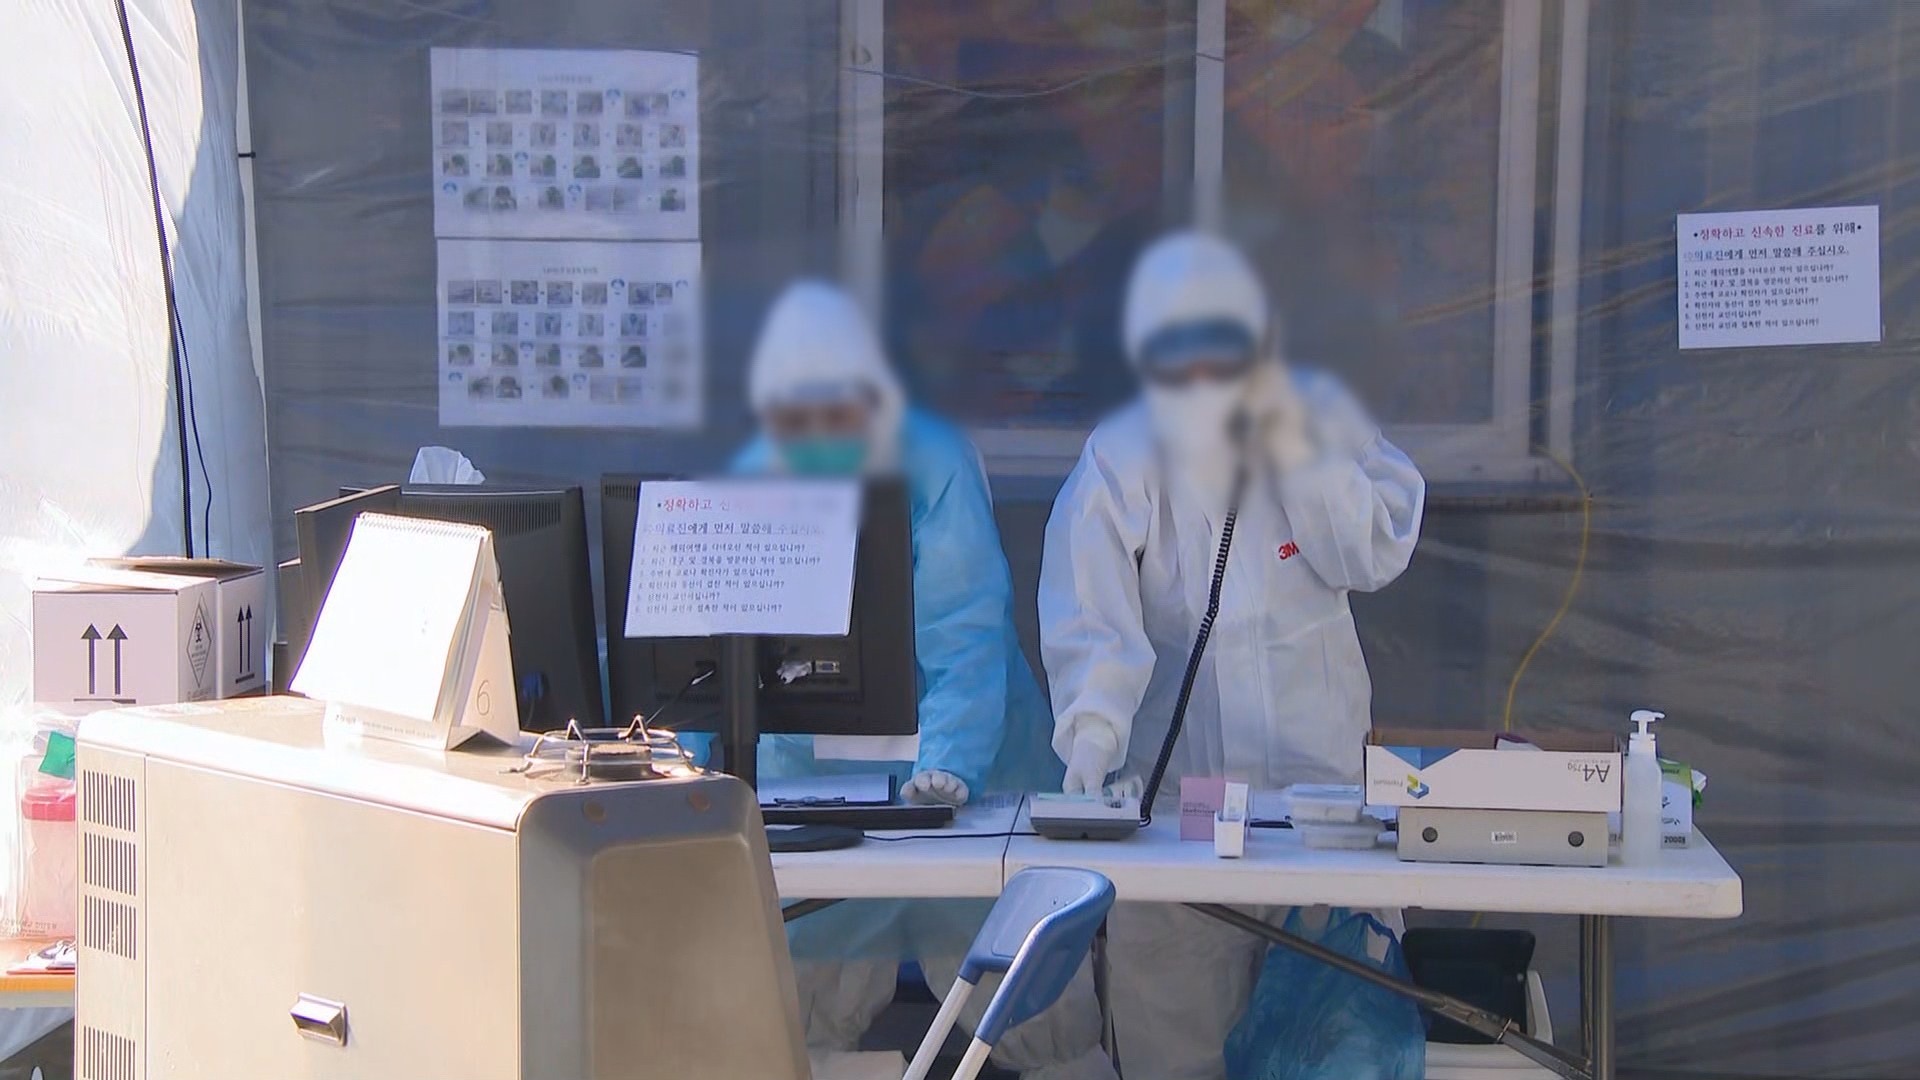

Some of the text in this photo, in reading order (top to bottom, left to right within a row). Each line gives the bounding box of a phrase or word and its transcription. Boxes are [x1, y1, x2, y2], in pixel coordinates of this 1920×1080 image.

[1700, 221, 1856, 241] 정확하고 신속한 진료를 위해
[1748, 247, 1768, 260] 먼저
[1772, 246, 1802, 259] 말씀해
[664, 497, 713, 512] 정확하고
[714, 521, 735, 535] 먼저
[1278, 541, 1300, 561] 3M
[476, 679, 492, 716] 6
[1582, 764, 1611, 783] A4
